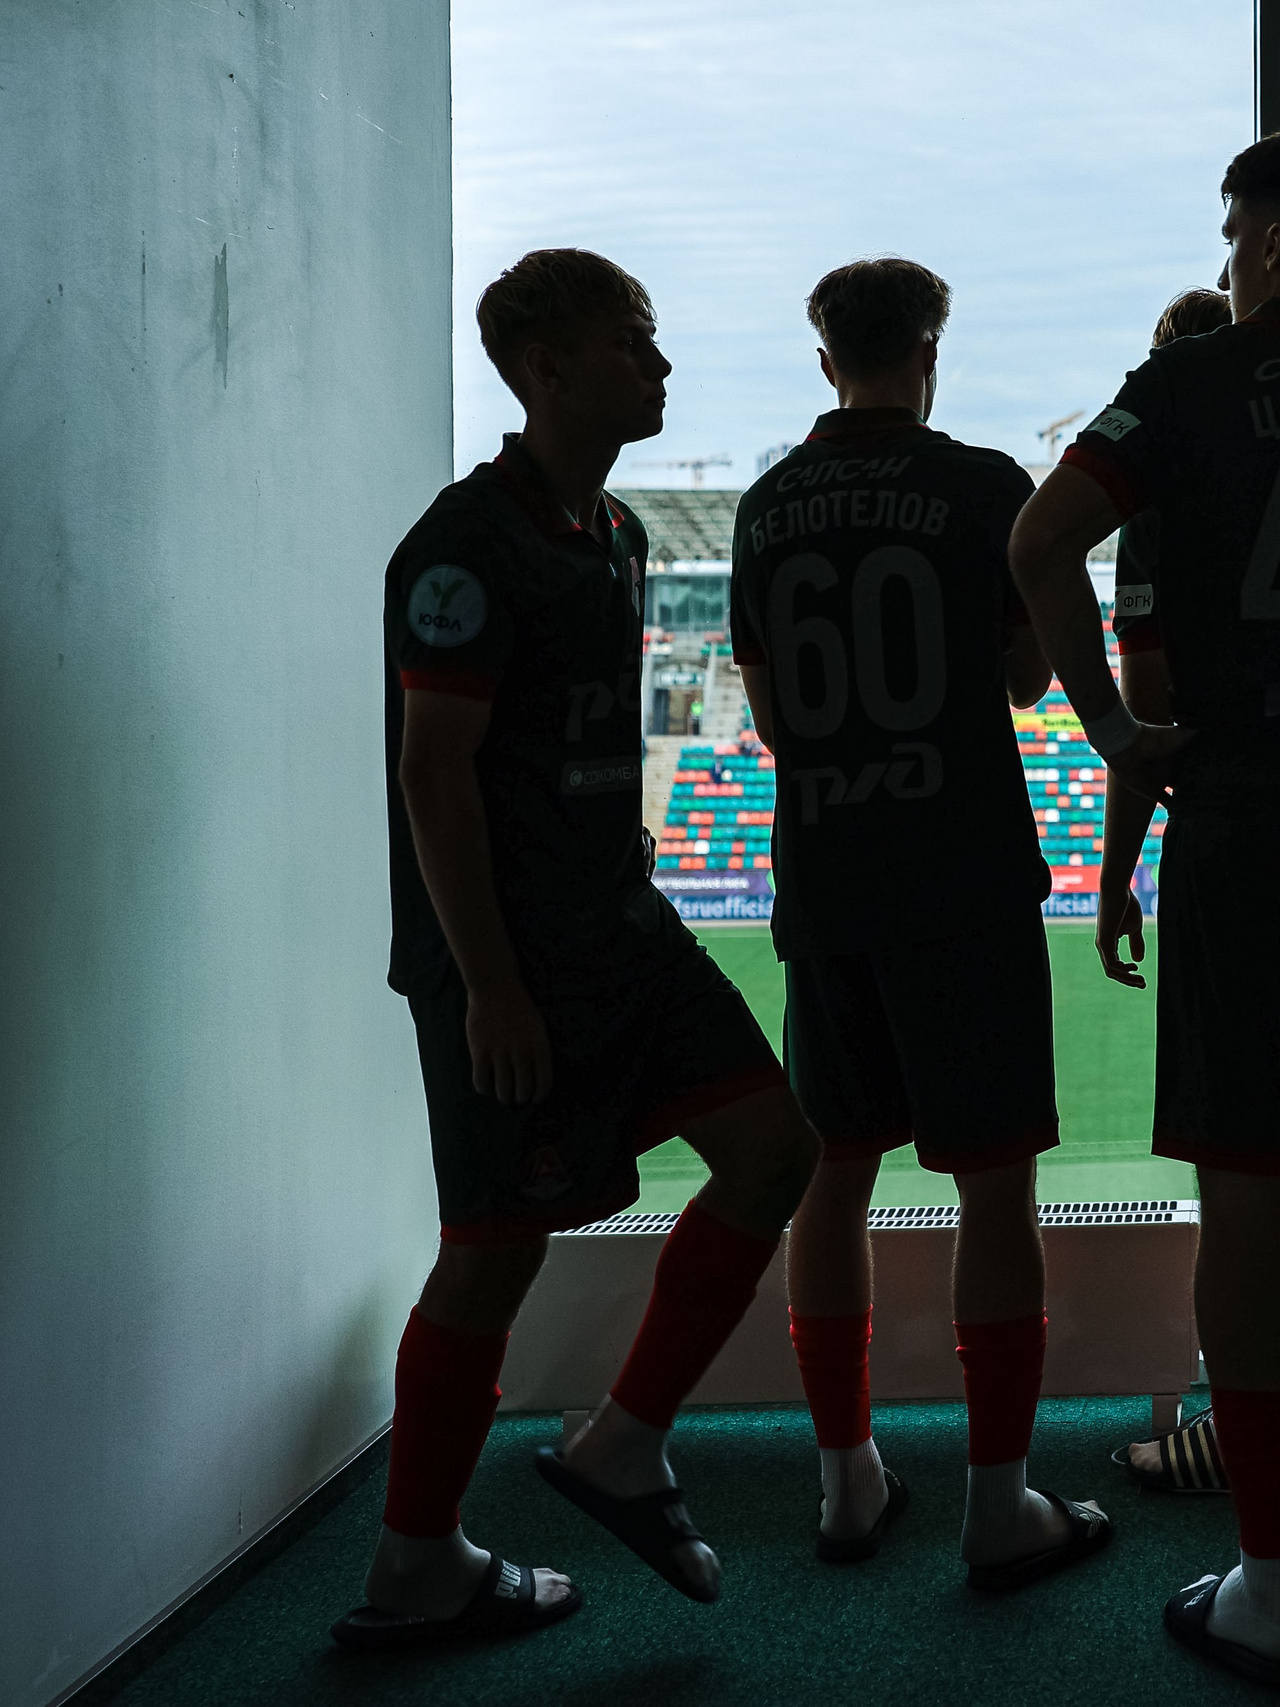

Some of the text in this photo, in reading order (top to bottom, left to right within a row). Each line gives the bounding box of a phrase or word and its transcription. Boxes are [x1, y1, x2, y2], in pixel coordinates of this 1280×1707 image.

[776, 456, 914, 493] САПСАН
[750, 489, 950, 556] БЕЛОТЕЛОВ
[1124, 594, 1151, 608] ФГК
[419, 613, 462, 632] ЮФЛ
[768, 545, 947, 740] 60
